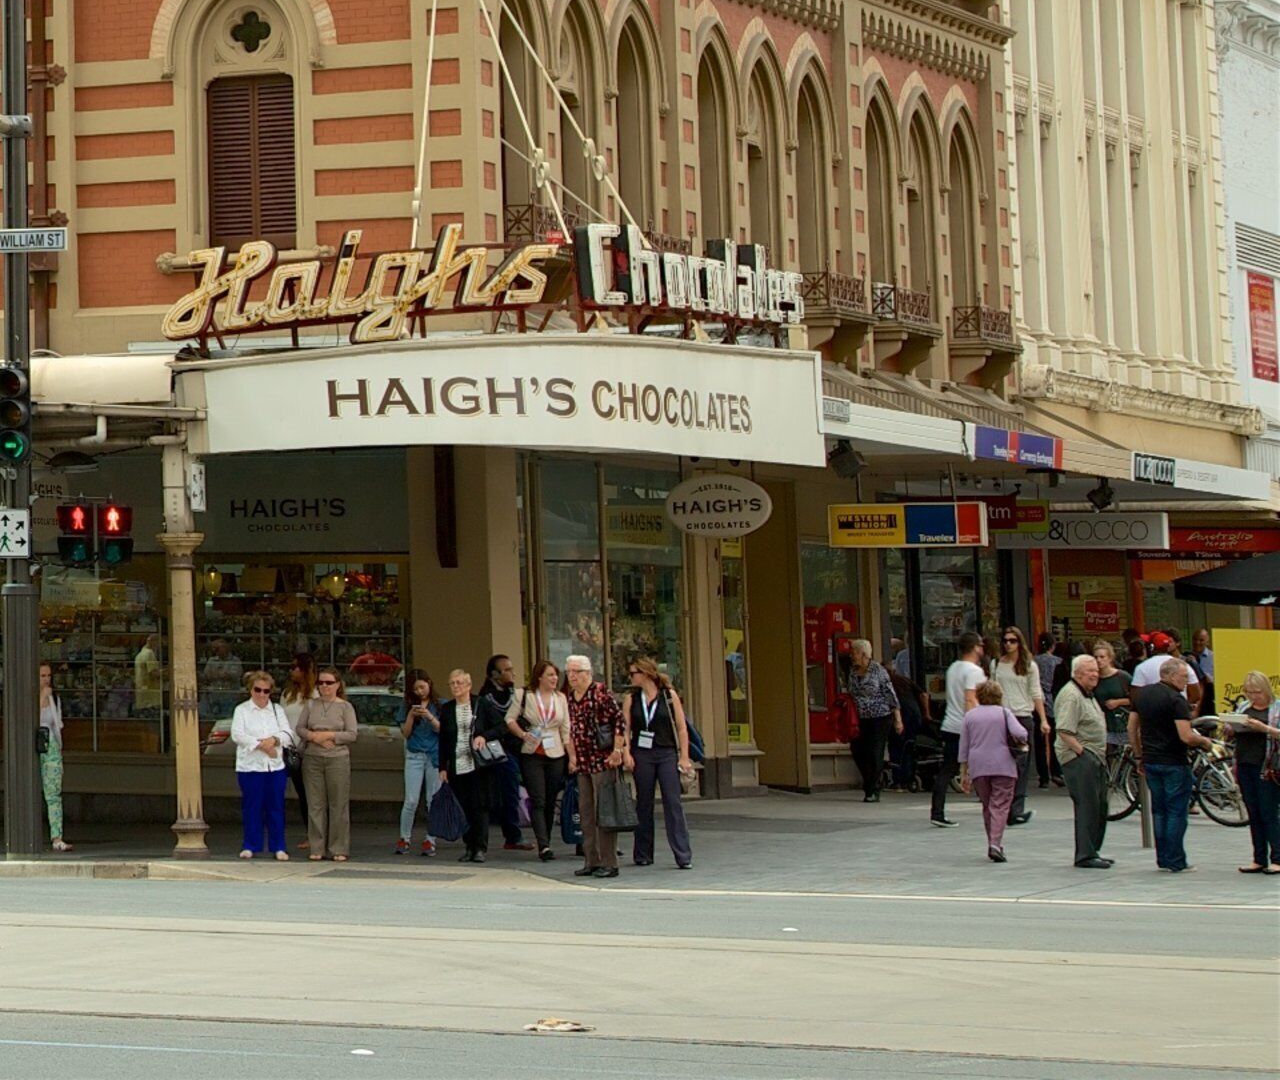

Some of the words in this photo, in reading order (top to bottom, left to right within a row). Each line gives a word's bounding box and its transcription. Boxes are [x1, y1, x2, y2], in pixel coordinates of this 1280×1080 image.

[0, 234, 44, 247] WILLIAM
[47, 233, 60, 246] ST
[161, 223, 559, 344] Haighs
[326, 376, 577, 418] HAIGH'S
[591, 380, 752, 434] CHOCOLATES
[230, 498, 346, 518] HAIGH'S
[673, 498, 761, 515] HAIGH'S
[838, 514, 887, 522] WESTERN
[247, 523, 330, 532] CHOCOLATES
[686, 521, 751, 530] CHOCOLATES
[854, 521, 888, 529] UNION
[918, 533, 954, 543] Travelex
[1187, 531, 1253, 541] Australia
